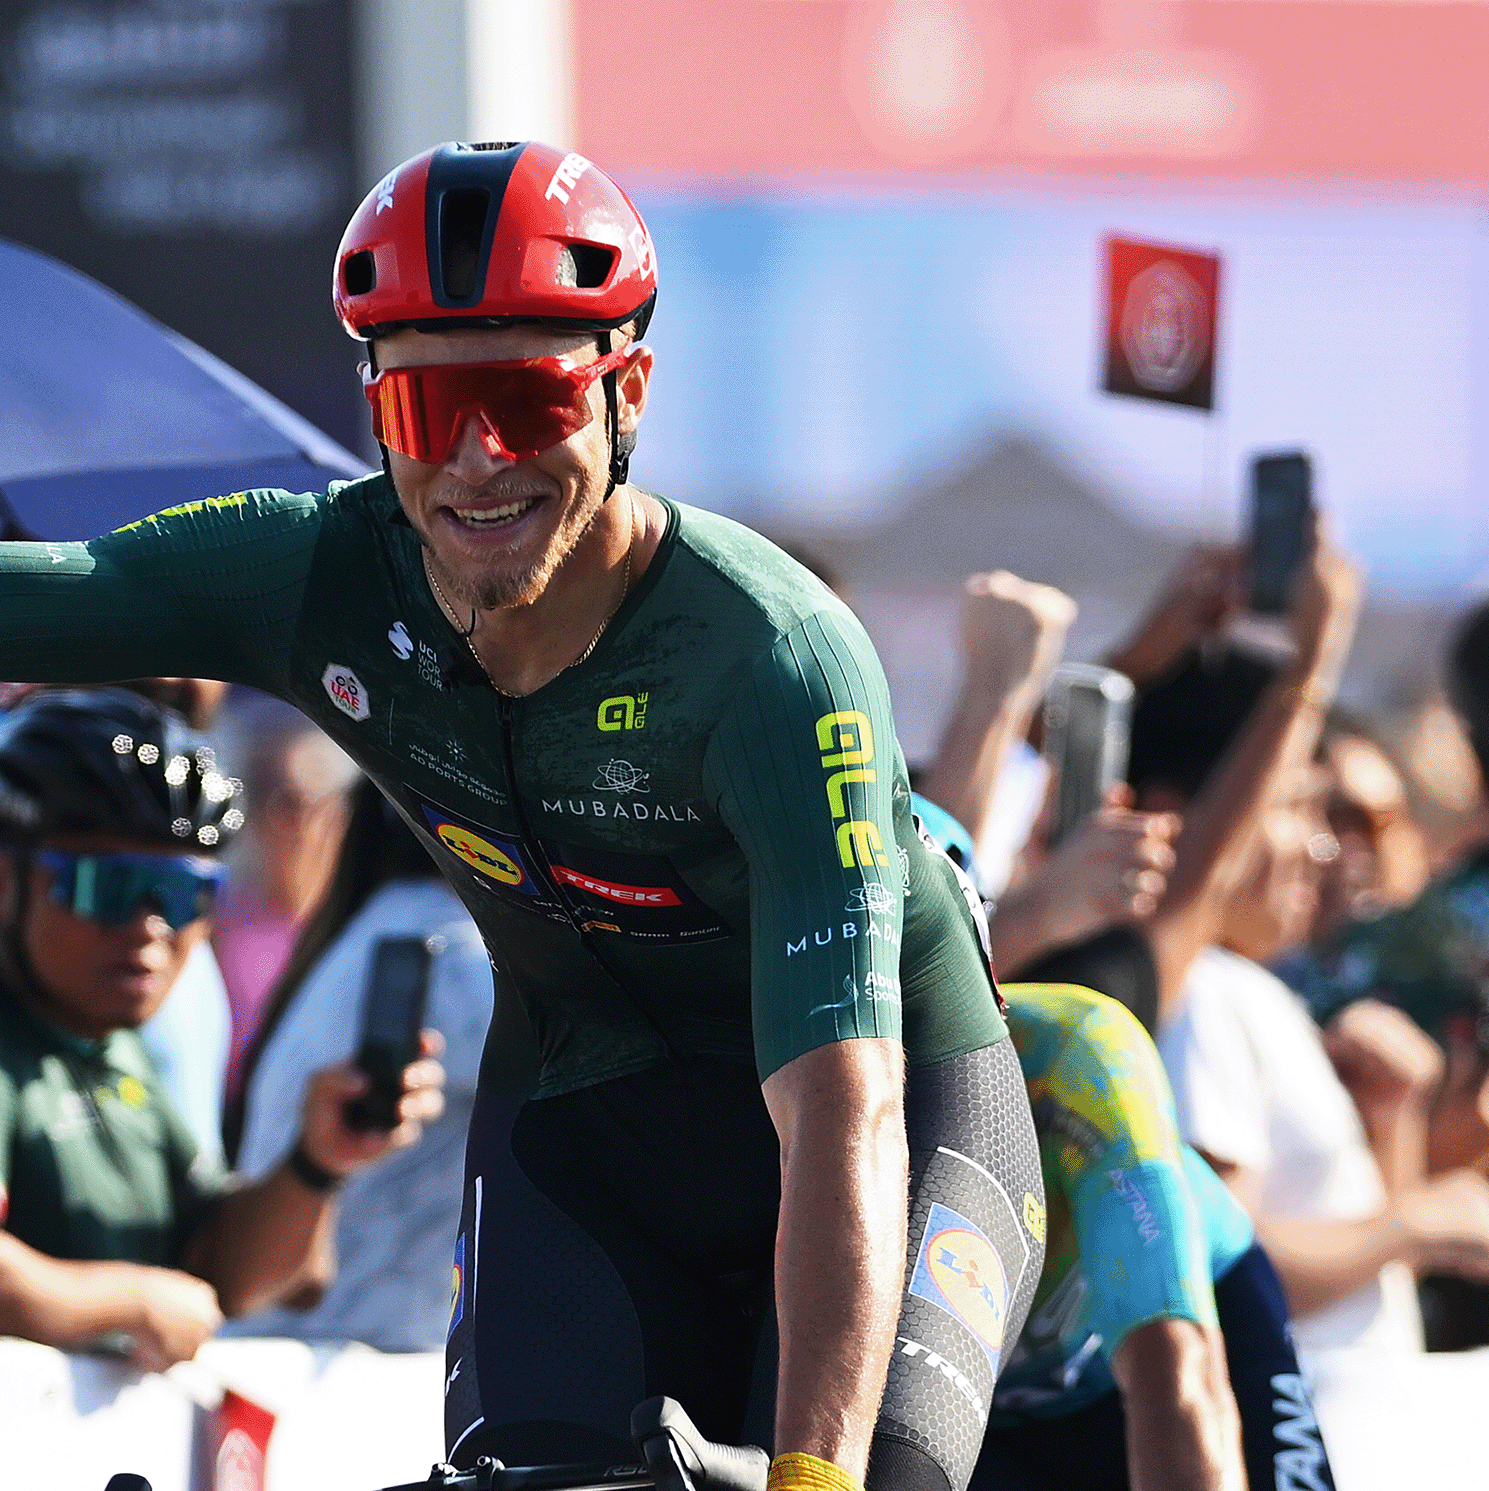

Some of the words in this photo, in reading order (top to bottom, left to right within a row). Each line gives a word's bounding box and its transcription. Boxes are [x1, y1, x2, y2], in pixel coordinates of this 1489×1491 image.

[418, 651, 441, 679] WOR
[419, 640, 437, 663] UCI
[418, 664, 443, 691] TOUR
[330, 680, 360, 711] UAE
[410, 753, 426, 766] AD
[428, 762, 465, 788] PORTS
[541, 798, 701, 822] MUBADALA
[561, 870, 663, 902] TREK
